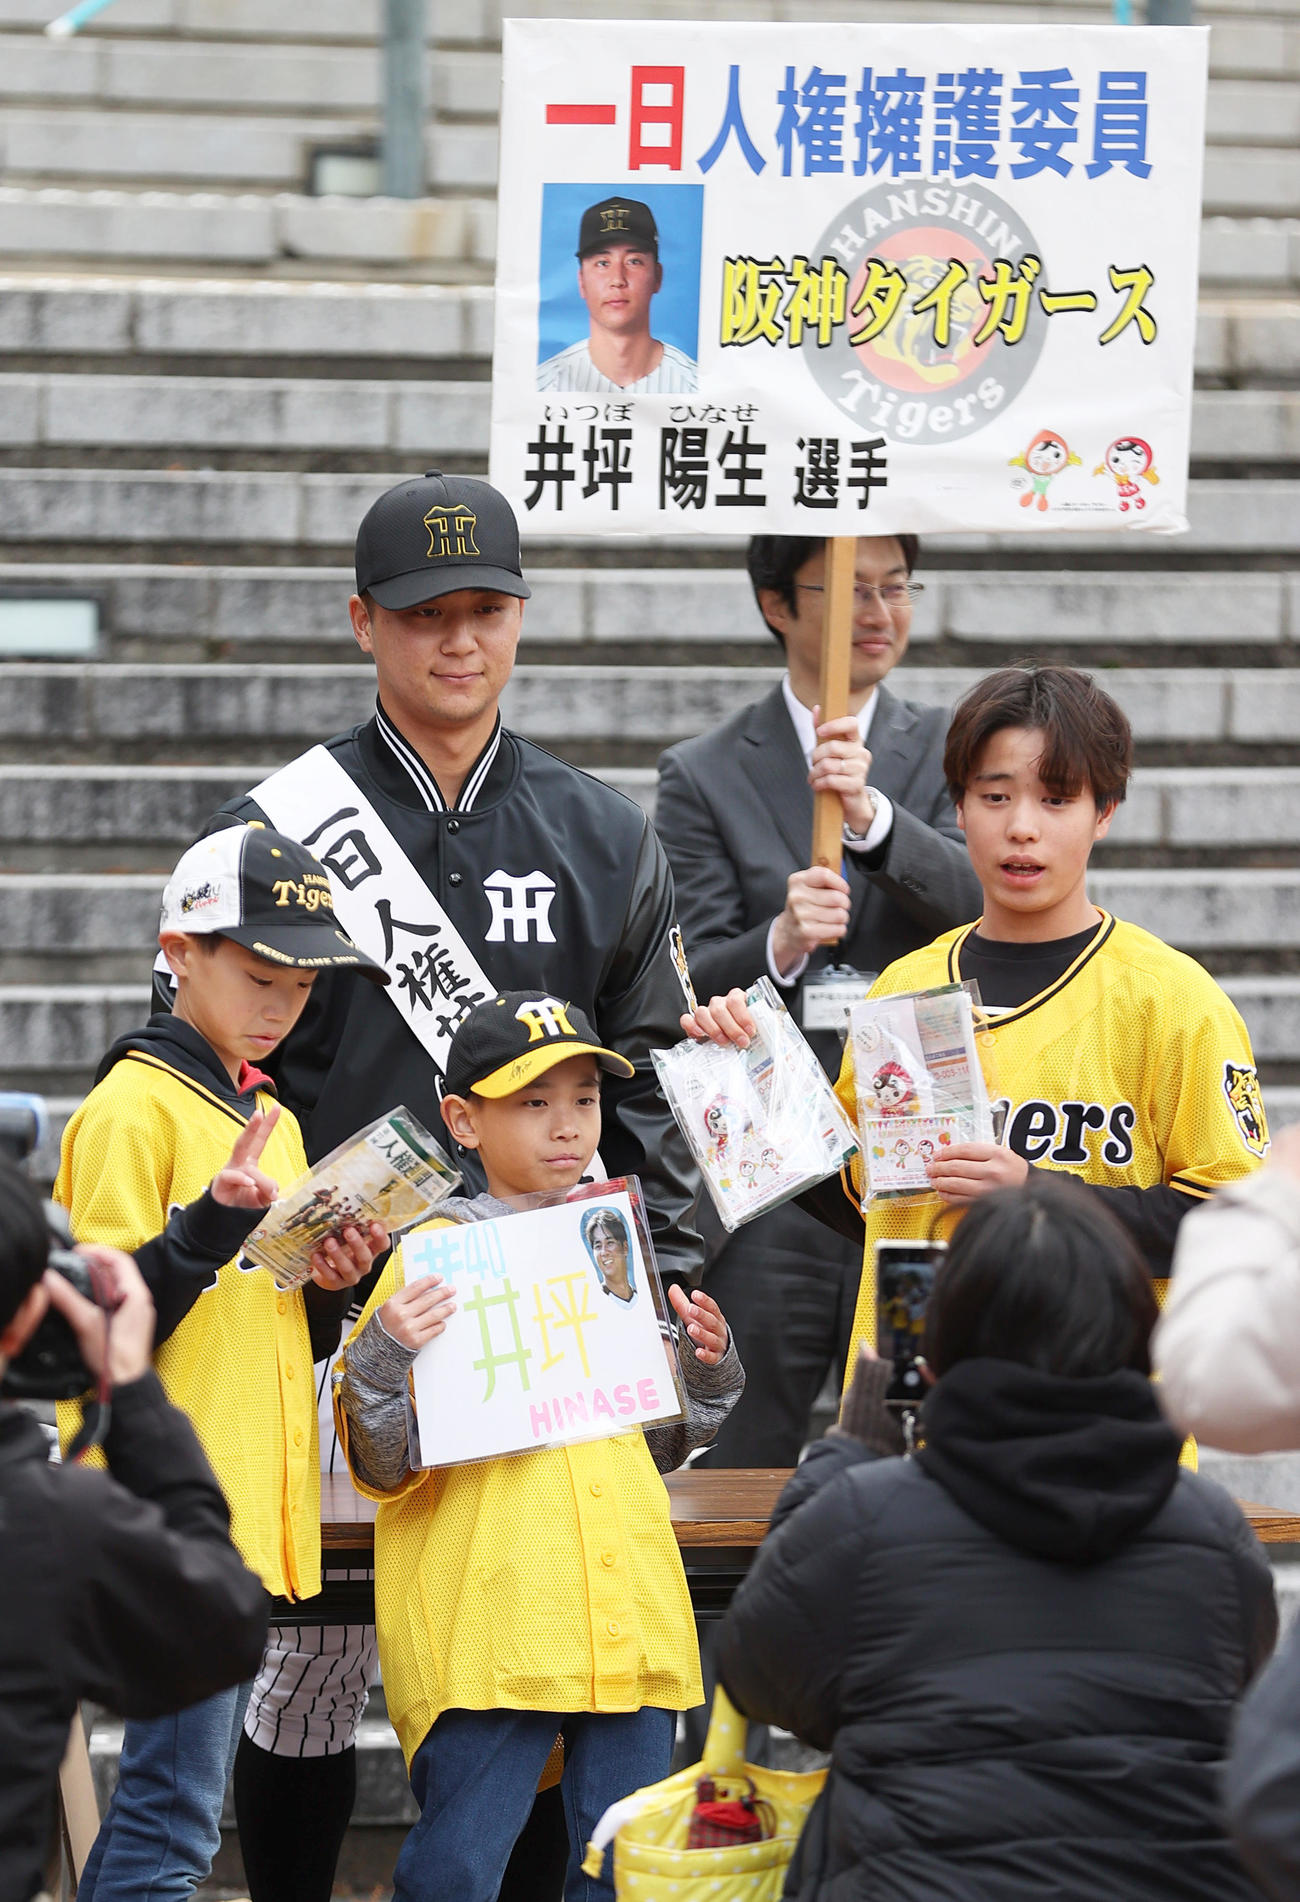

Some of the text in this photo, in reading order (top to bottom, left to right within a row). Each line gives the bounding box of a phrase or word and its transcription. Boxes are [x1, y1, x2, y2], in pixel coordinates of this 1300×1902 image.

[545, 64, 1153, 180] 一日人権擁護委員
[830, 186, 1022, 262] HANSHIN
[720, 254, 1158, 349] 阪神タイガース
[543, 402, 760, 423] いつぼ ひなせ
[837, 368, 1007, 439] Tigers
[525, 424, 888, 511] 井坪 陽生 選手
[998, 1099, 1135, 1166] ers
[463, 1270, 599, 1404] 井坪
[528, 1377, 661, 1439] HINASE
